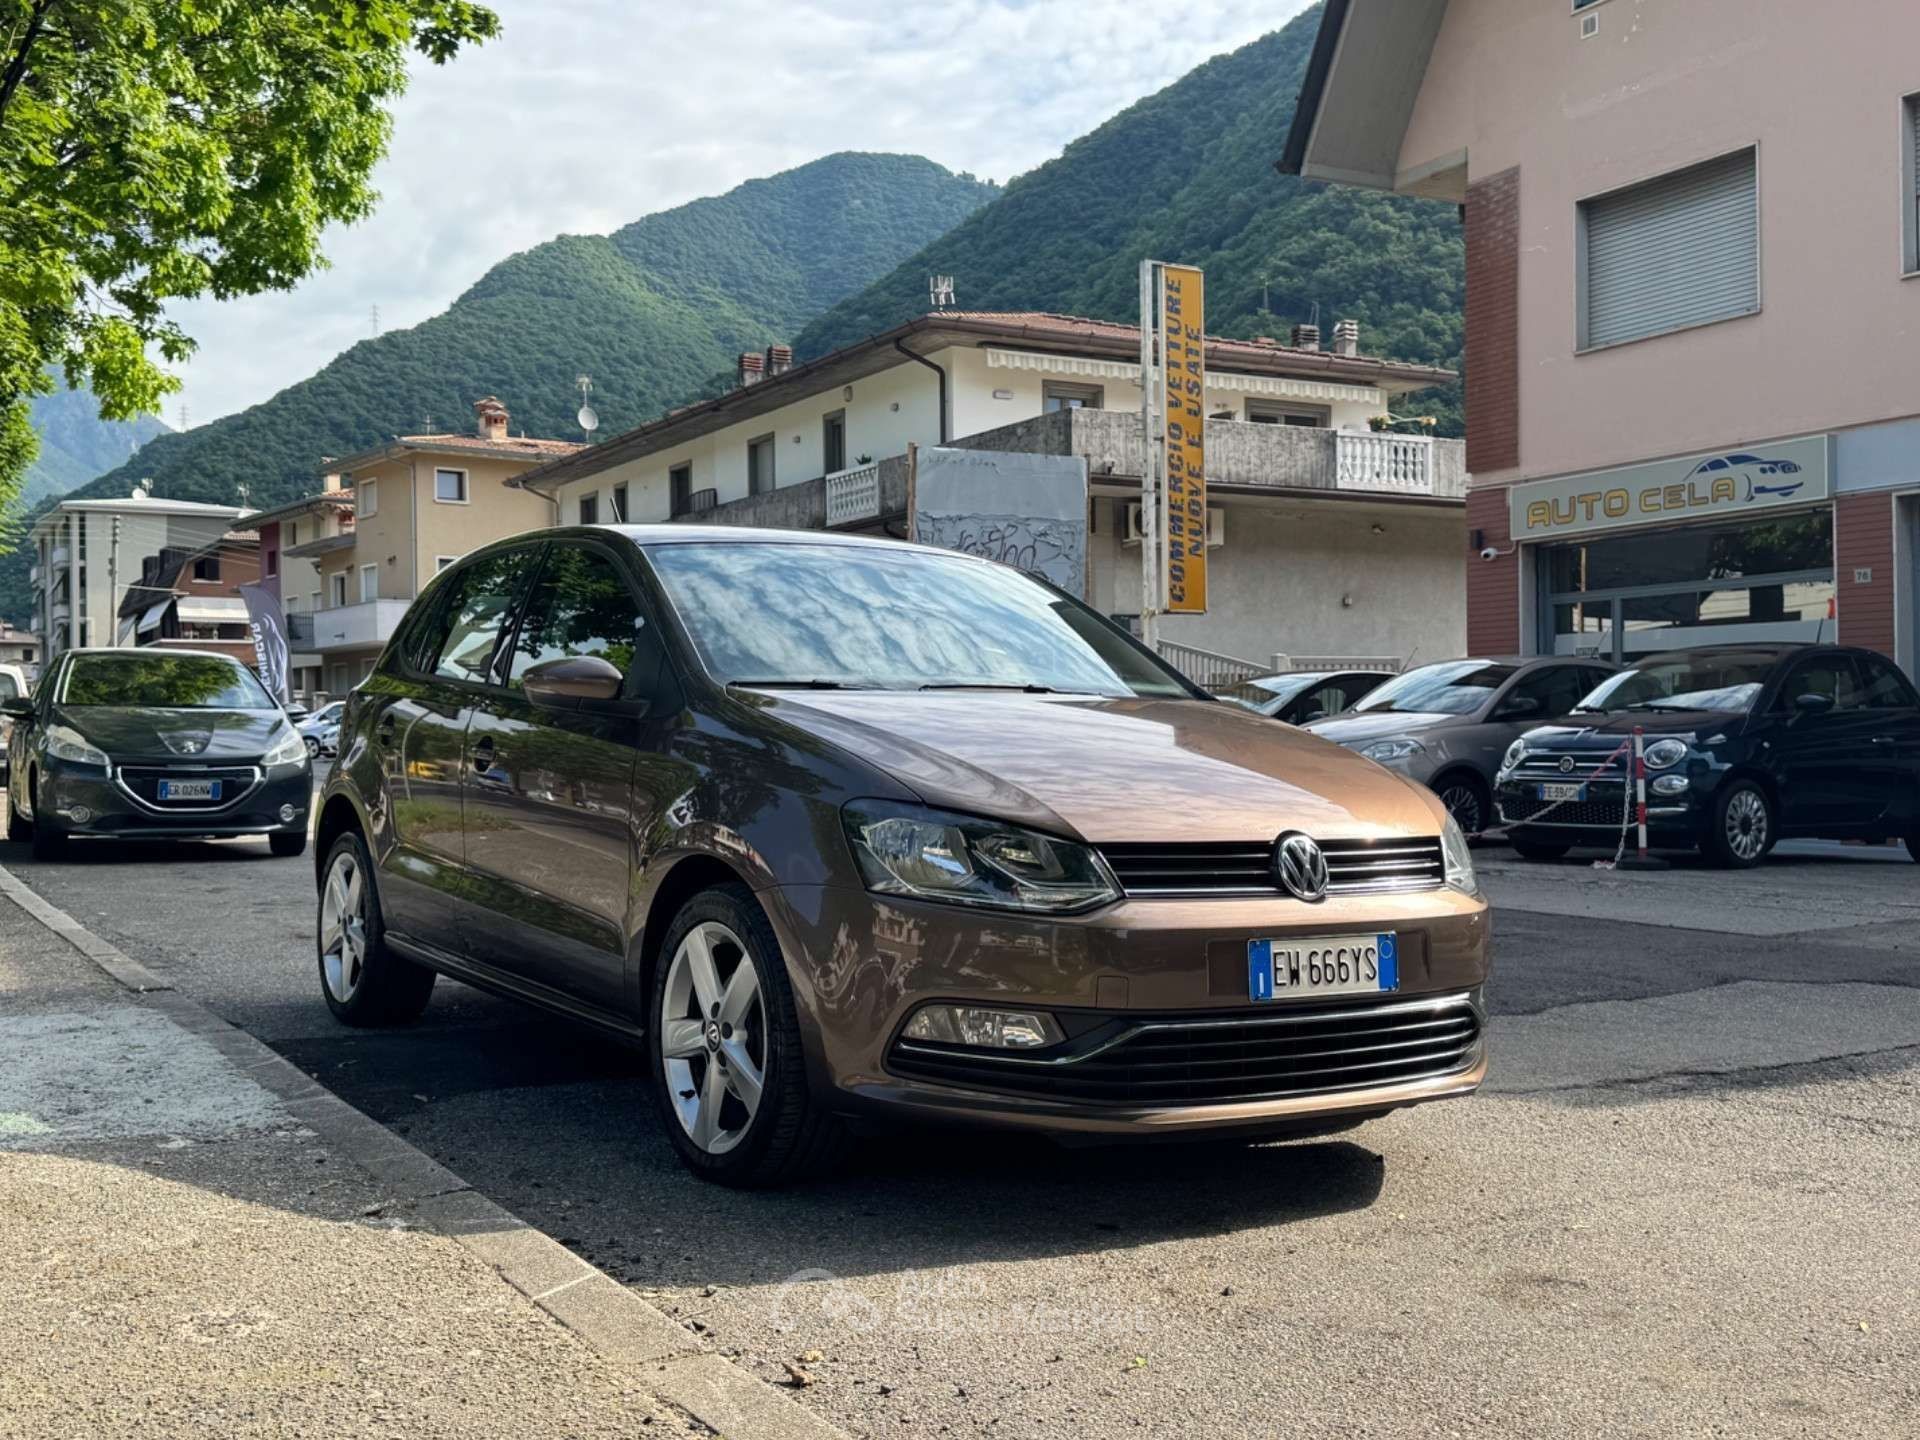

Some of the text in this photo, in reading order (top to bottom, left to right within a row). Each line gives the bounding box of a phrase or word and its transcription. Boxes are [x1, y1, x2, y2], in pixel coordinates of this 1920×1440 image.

[1166, 276, 1186, 603] COMMERCIO VETTURE
[1184, 323, 1203, 558] NUOVE E USATE
[1526, 476, 1736, 529] AUTO CELA
